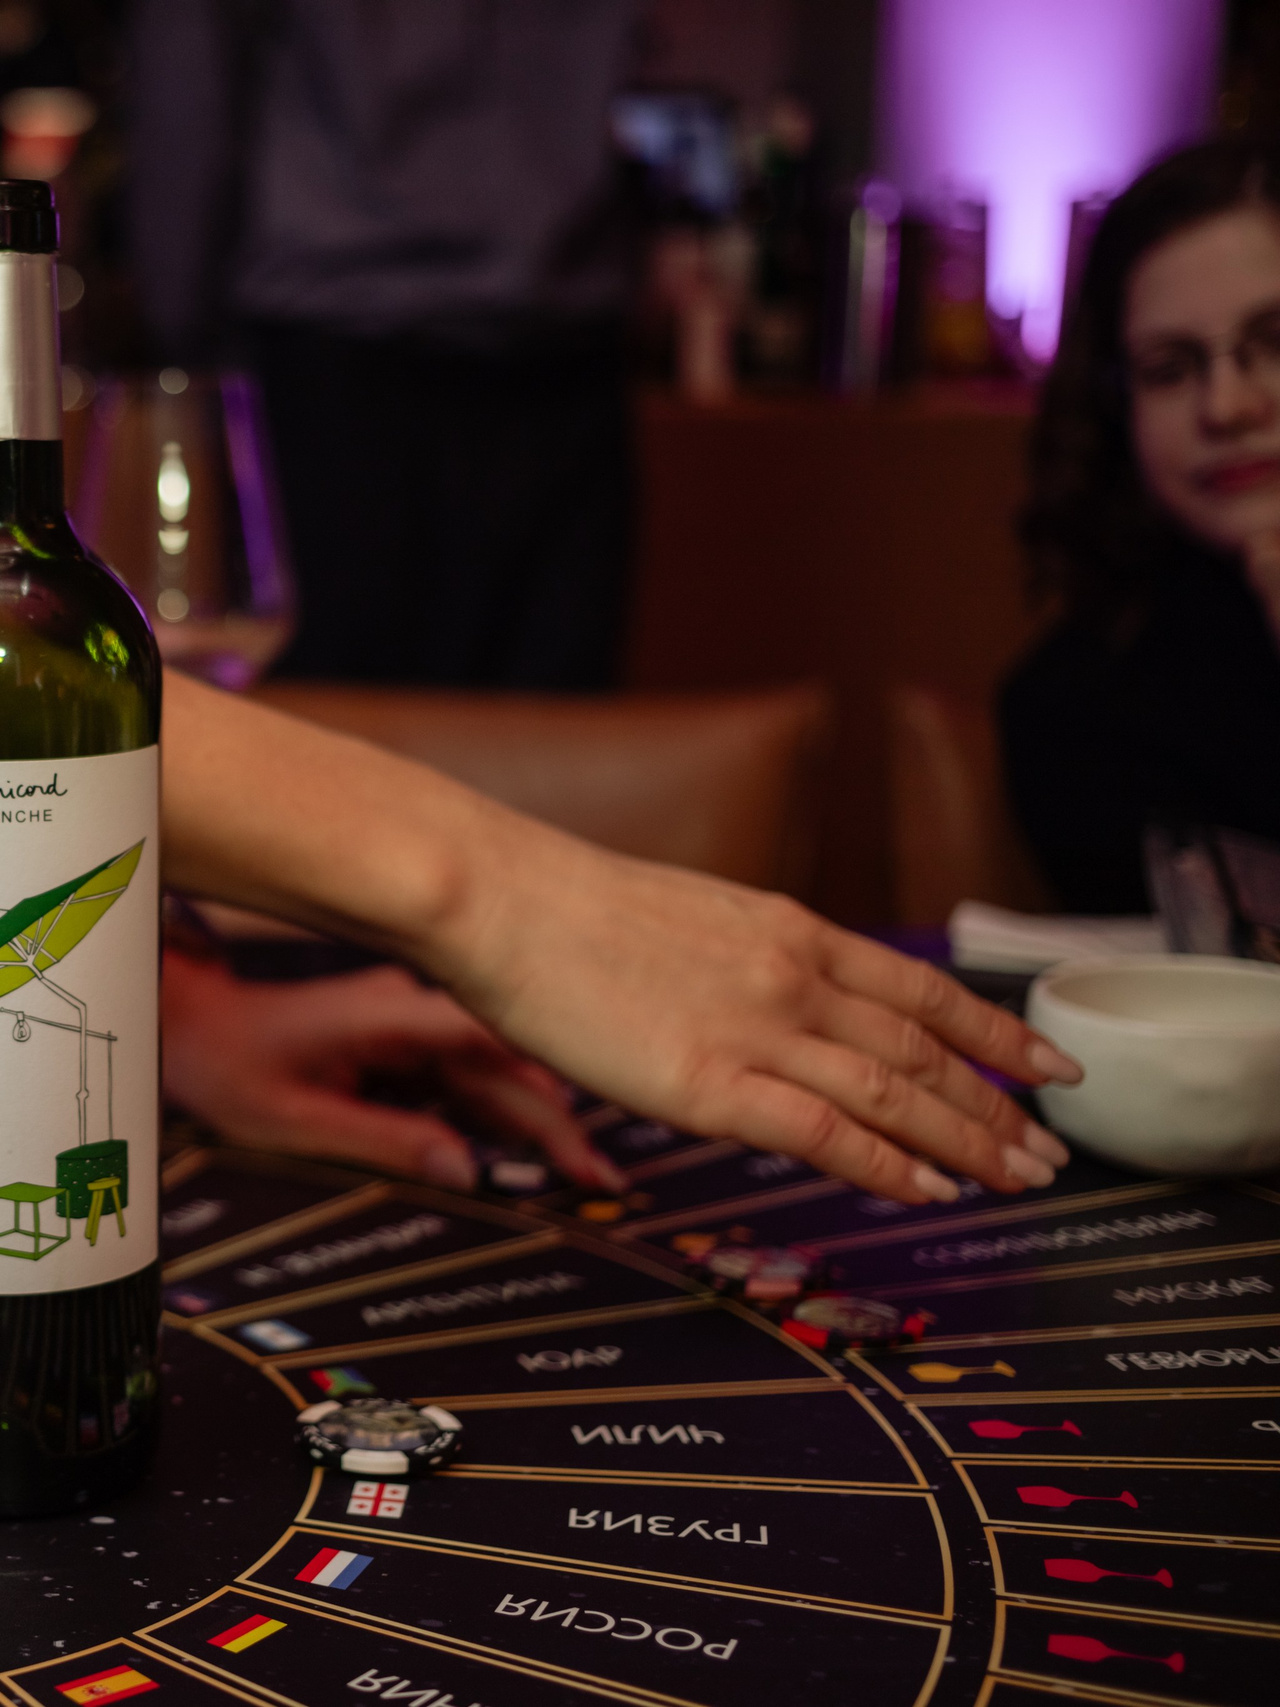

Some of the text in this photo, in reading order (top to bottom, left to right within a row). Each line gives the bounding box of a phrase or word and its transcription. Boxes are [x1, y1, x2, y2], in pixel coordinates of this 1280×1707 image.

[571, 1424, 726, 1445] ЧИЛИ
[568, 1507, 769, 1546] ГРУЗИЯ
[494, 1593, 739, 1660] РОССИЯ
